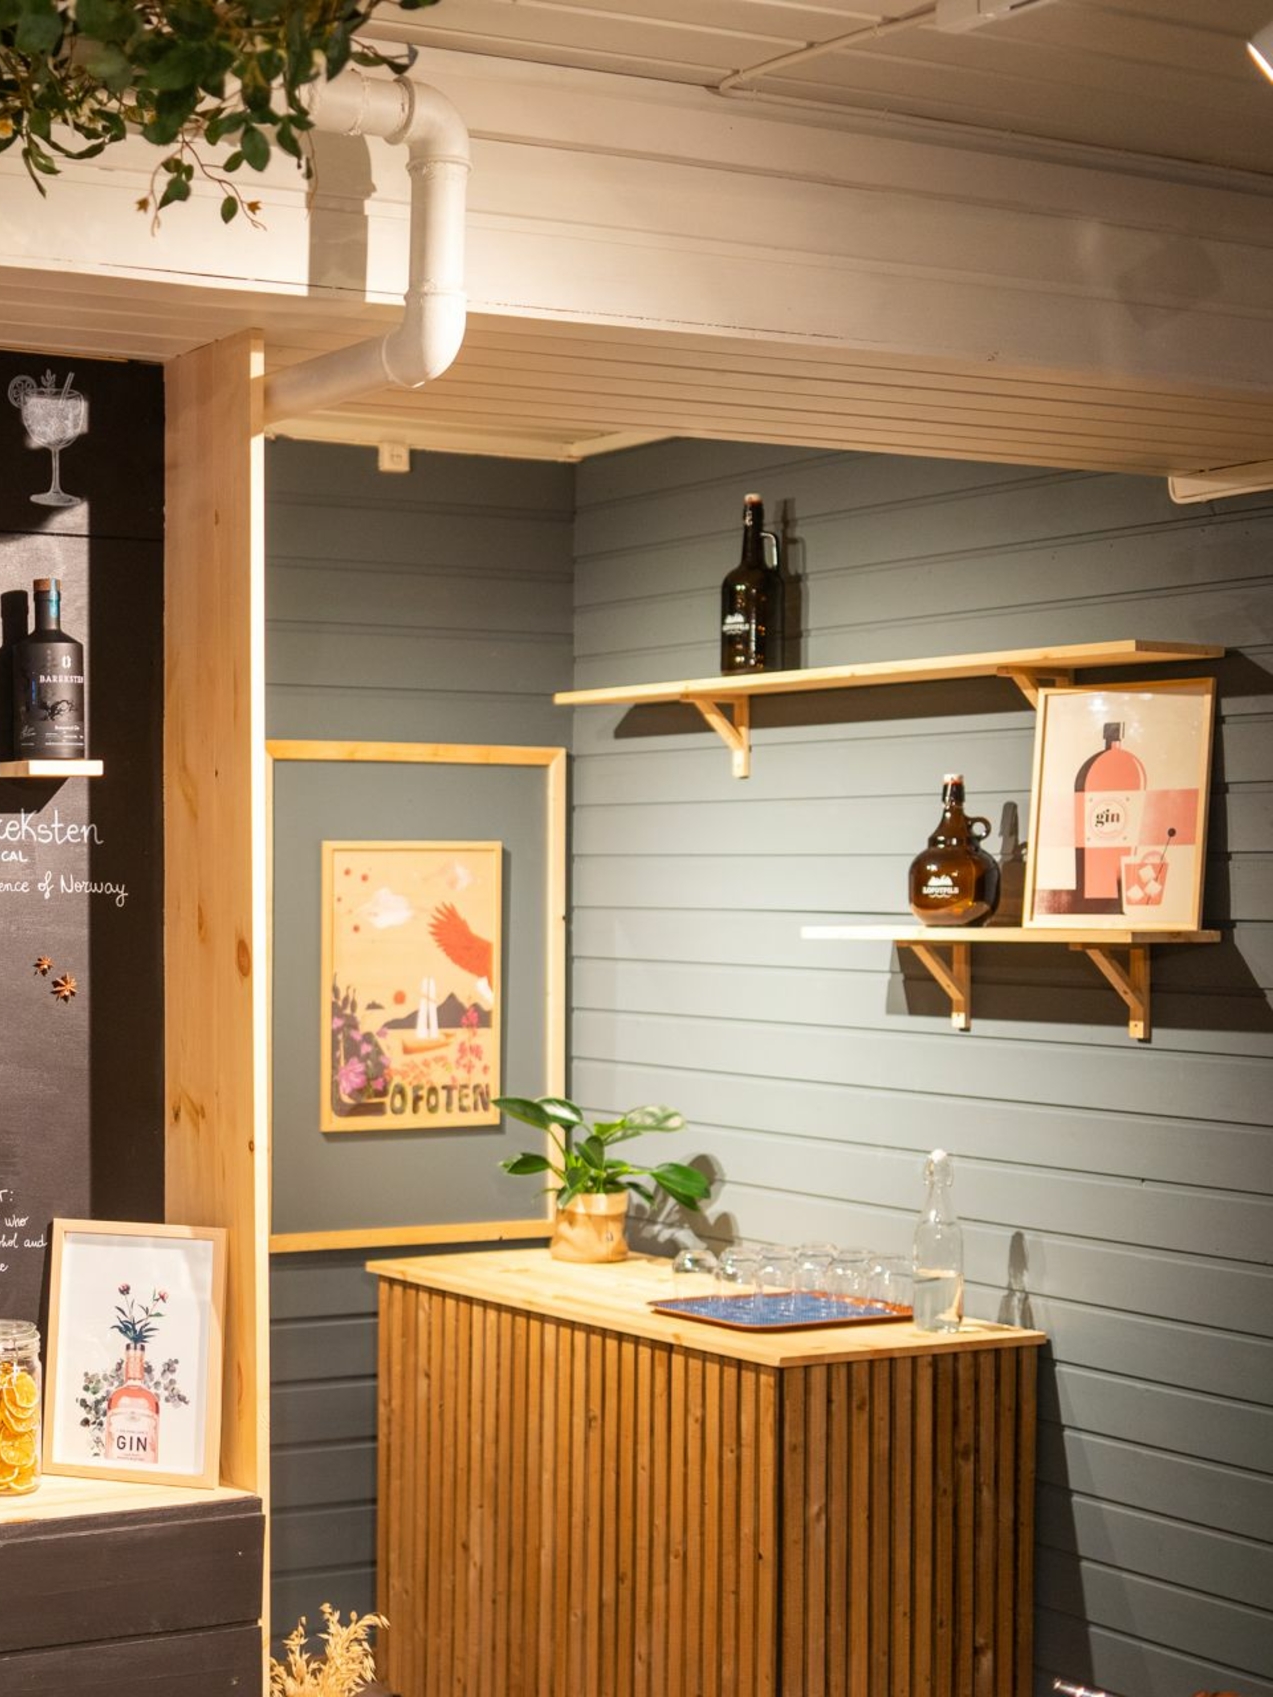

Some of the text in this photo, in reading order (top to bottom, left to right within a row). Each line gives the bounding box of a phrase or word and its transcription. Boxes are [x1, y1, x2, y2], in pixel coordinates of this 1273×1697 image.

[1094, 807, 1122, 829] gin
[38, 871, 54, 899] of
[59, 874, 129, 907] Norway
[4, 1215, 30, 1228] who
[23, 1233, 48, 1249] and
[116, 1435, 147, 1452] GIN
